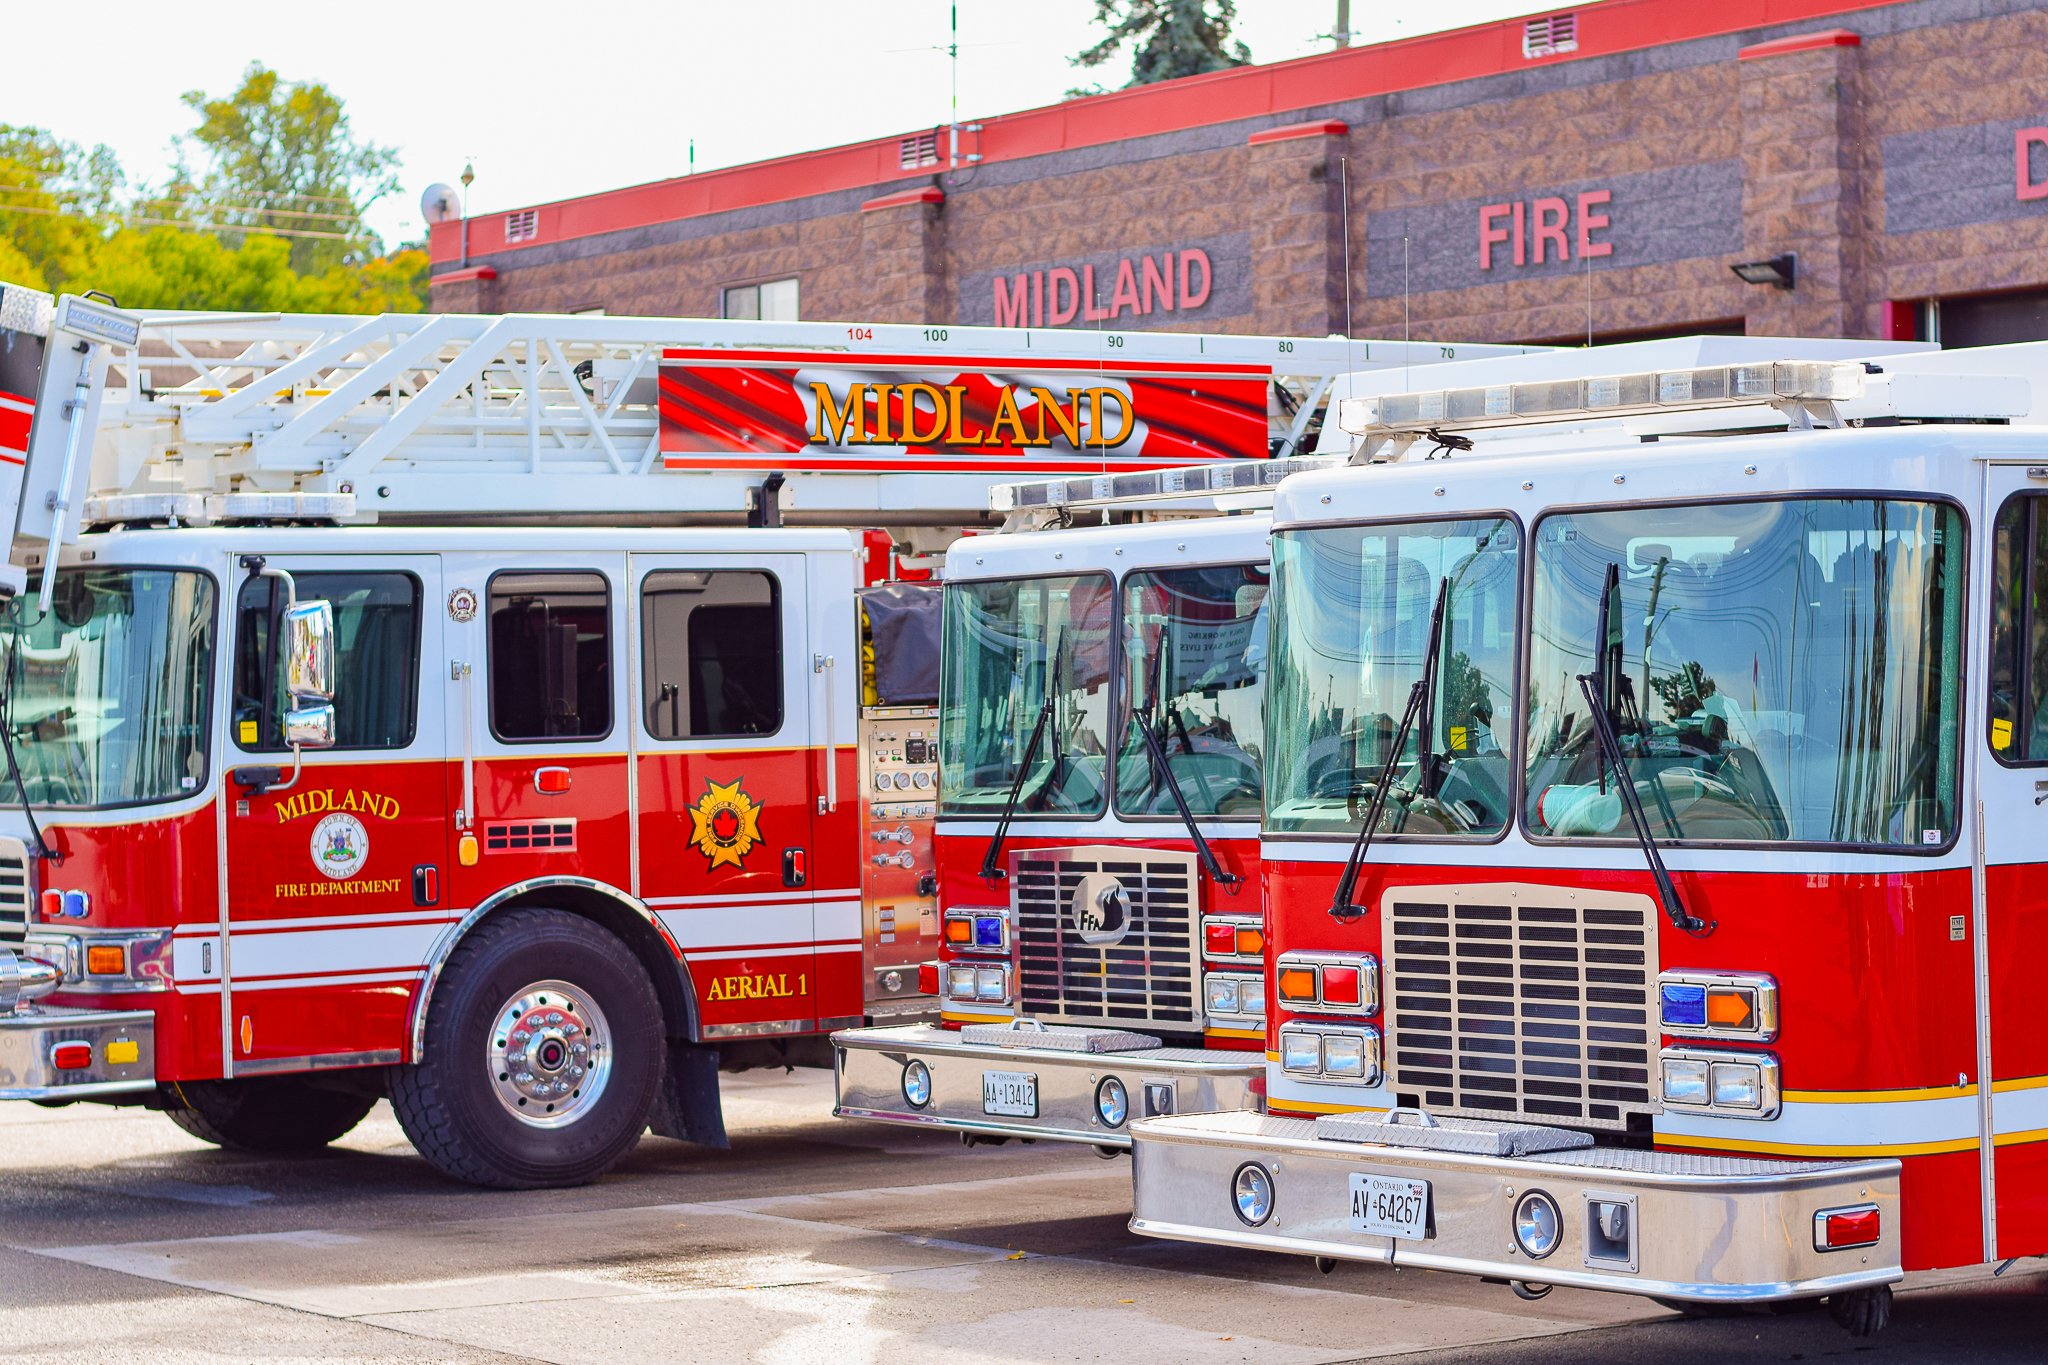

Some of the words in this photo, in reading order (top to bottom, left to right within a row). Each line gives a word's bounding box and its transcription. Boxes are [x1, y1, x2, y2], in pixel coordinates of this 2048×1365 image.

[993, 248, 1212, 328] MIDLAND
[1479, 189, 1613, 270] FIRE
[847, 328, 873, 341] 104
[923, 329, 948, 342] 100
[1107, 335, 1124, 348] 90
[1278, 341, 1293, 353] 80
[1440, 347, 1455, 359] 70
[809, 381, 1135, 449] MIDLAND
[274, 788, 400, 824] MIDLAND
[321, 814, 345, 828] TOWN
[275, 883, 307, 898] FIRE
[310, 879, 402, 896] DEPARTMENT
[1080, 910, 1101, 931] FFA
[707, 974, 793, 1001] AERIAL
[799, 973, 807, 995] 1
[1373, 1180, 1404, 1192] ONTARIO
[1378, 1193, 1422, 1225] 64267
